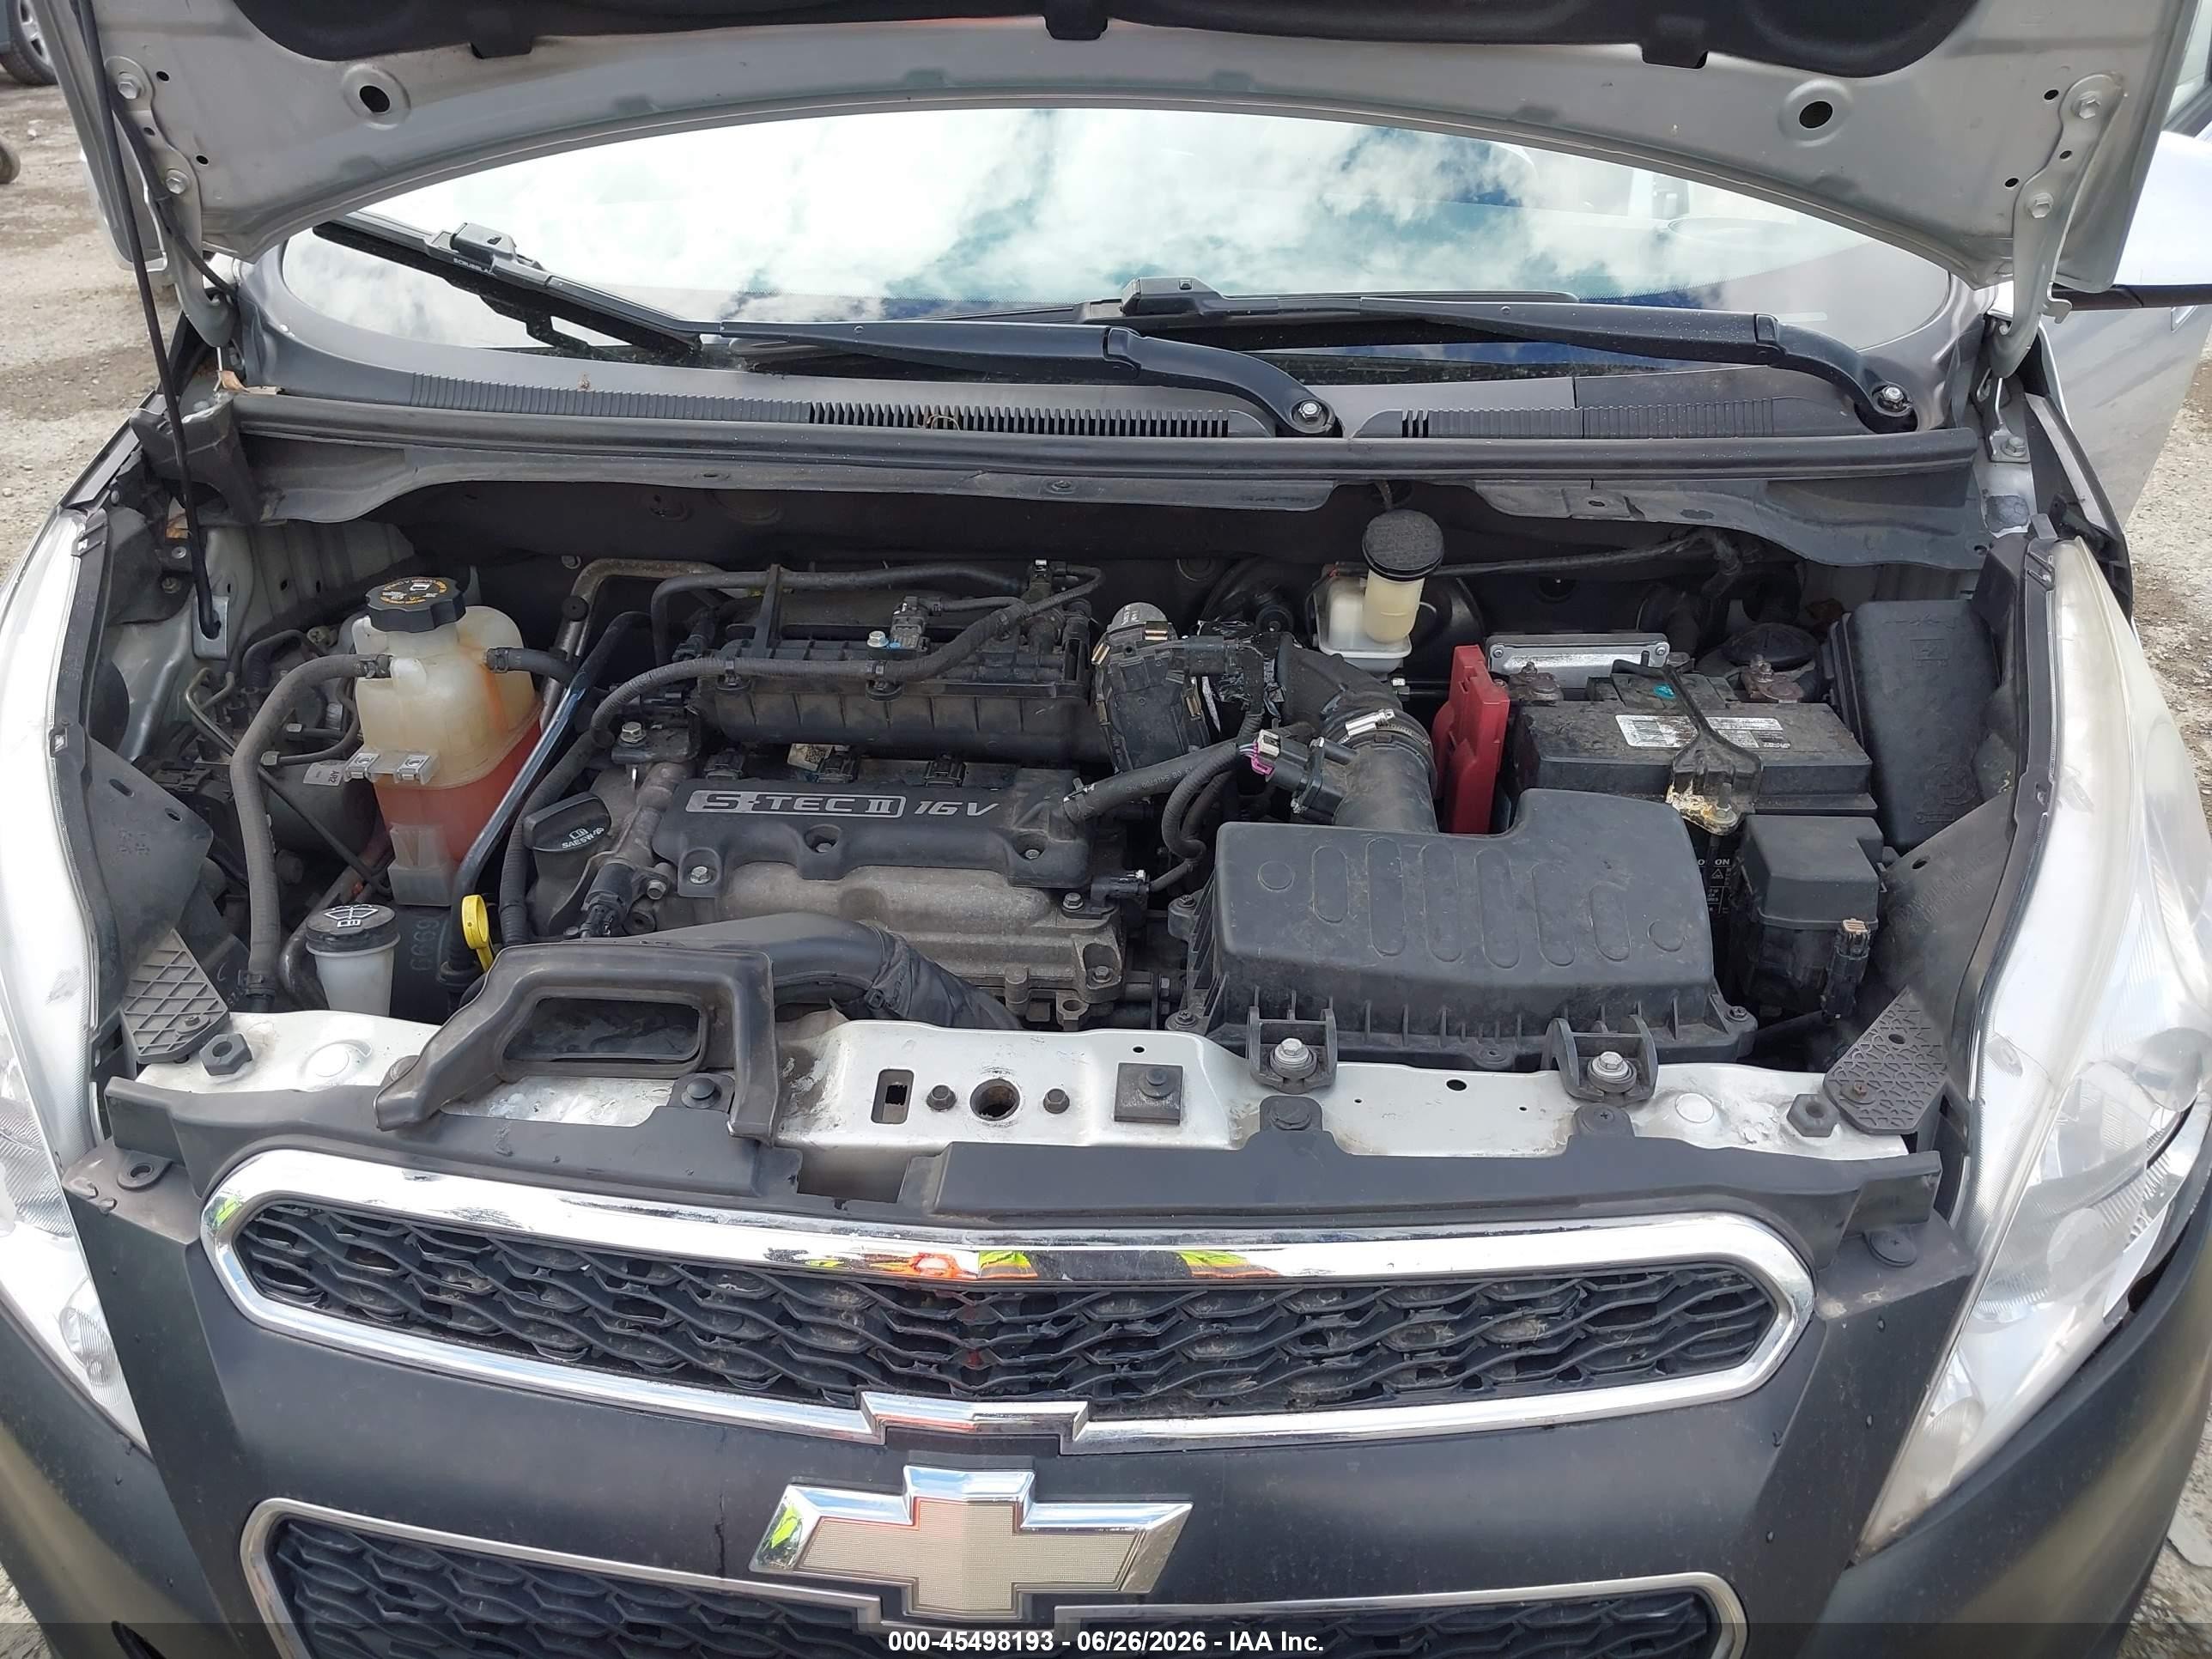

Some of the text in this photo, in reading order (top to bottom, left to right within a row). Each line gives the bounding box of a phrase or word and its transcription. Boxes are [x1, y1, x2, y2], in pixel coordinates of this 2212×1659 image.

[702, 793, 1000, 816] S-TEC II 16V
[562, 839, 581, 848] SAE
